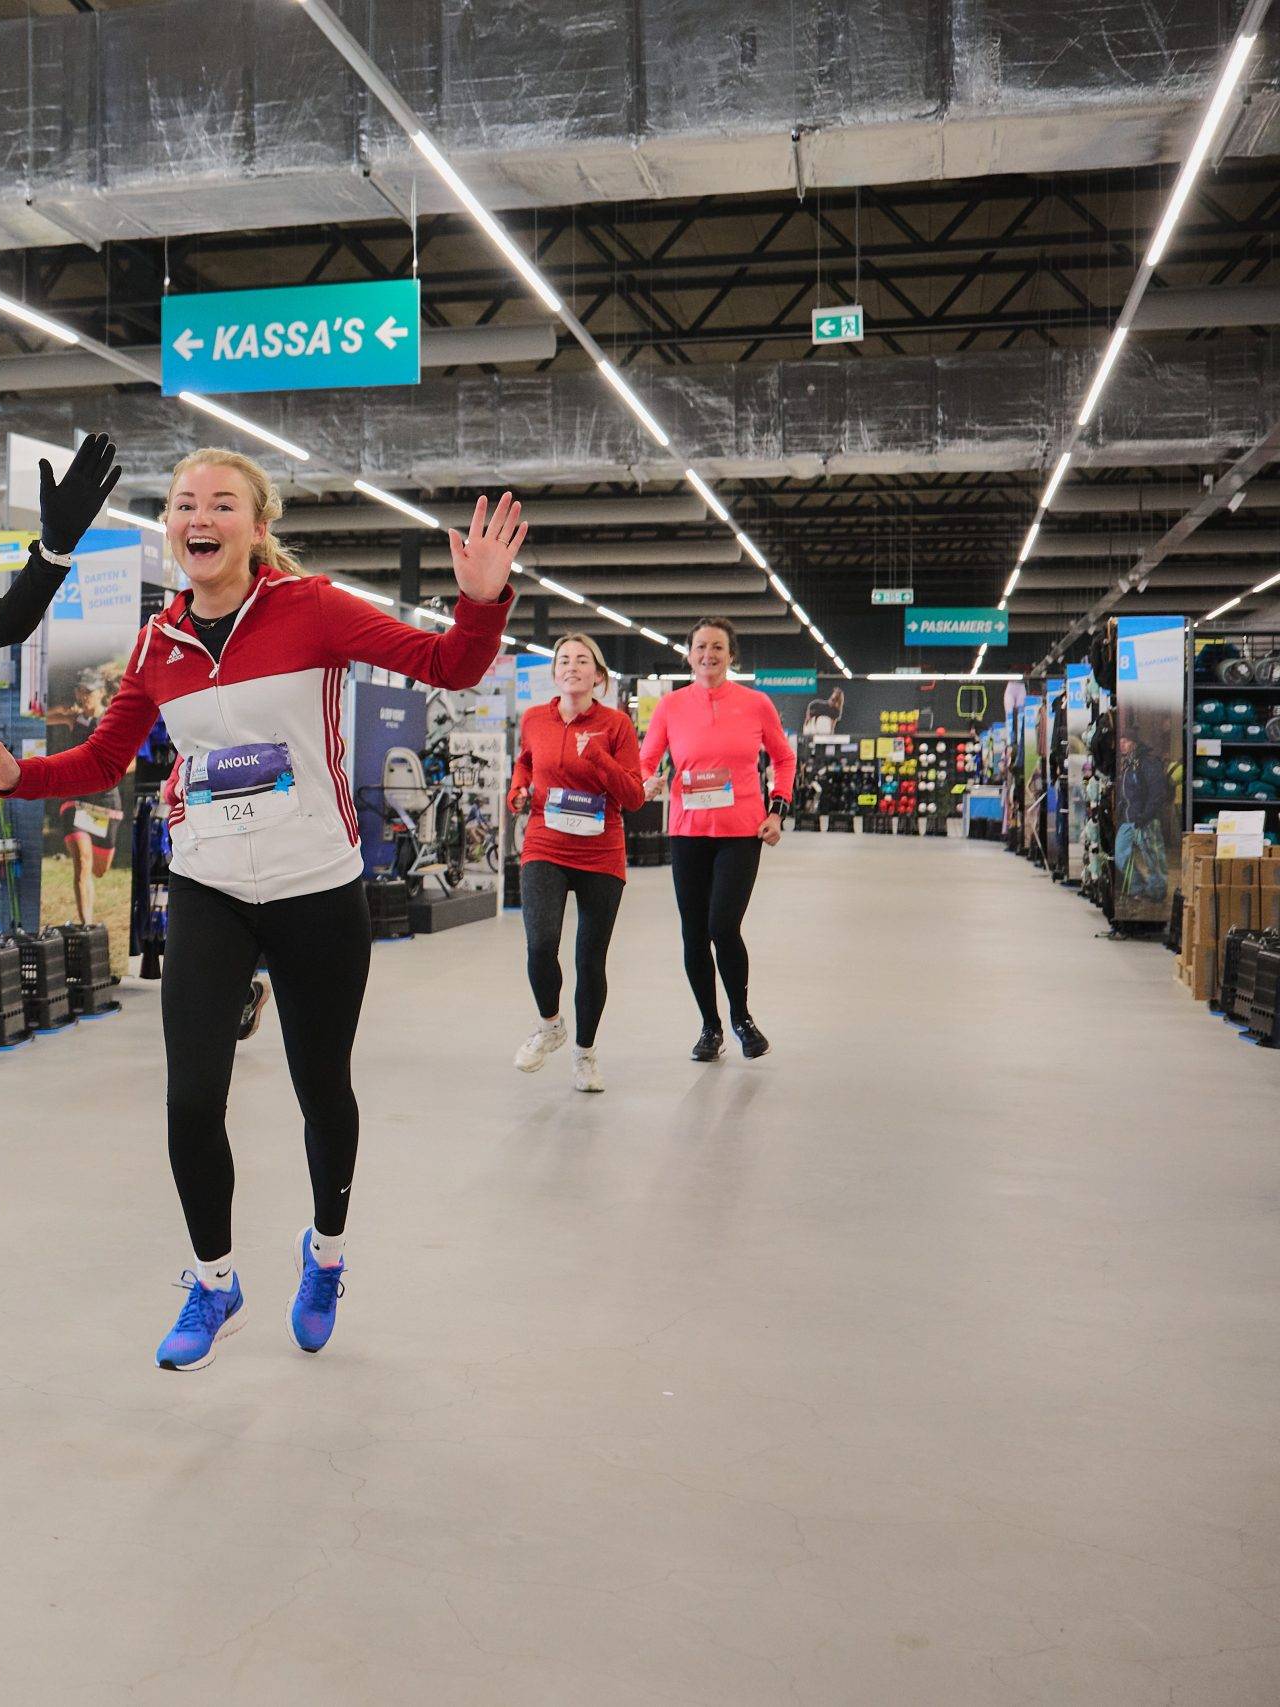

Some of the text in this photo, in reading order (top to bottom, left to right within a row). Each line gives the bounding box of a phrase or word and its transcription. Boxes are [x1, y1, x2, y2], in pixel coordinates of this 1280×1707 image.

[212, 317, 366, 361] KASSA'S
[84, 569, 129, 584] DARTEN &
[920, 620, 993, 634] PASKAMERS
[166, 653, 185, 665] adidas
[1119, 655, 1131, 669] 8
[762, 676, 808, 687] PASKAMERS
[217, 754, 260, 770] ANOUK
[697, 773, 716, 782] HILDA
[567, 793, 593, 804] NIENKE
[222, 802, 255, 821] 124
[565, 816, 582, 828] 127
